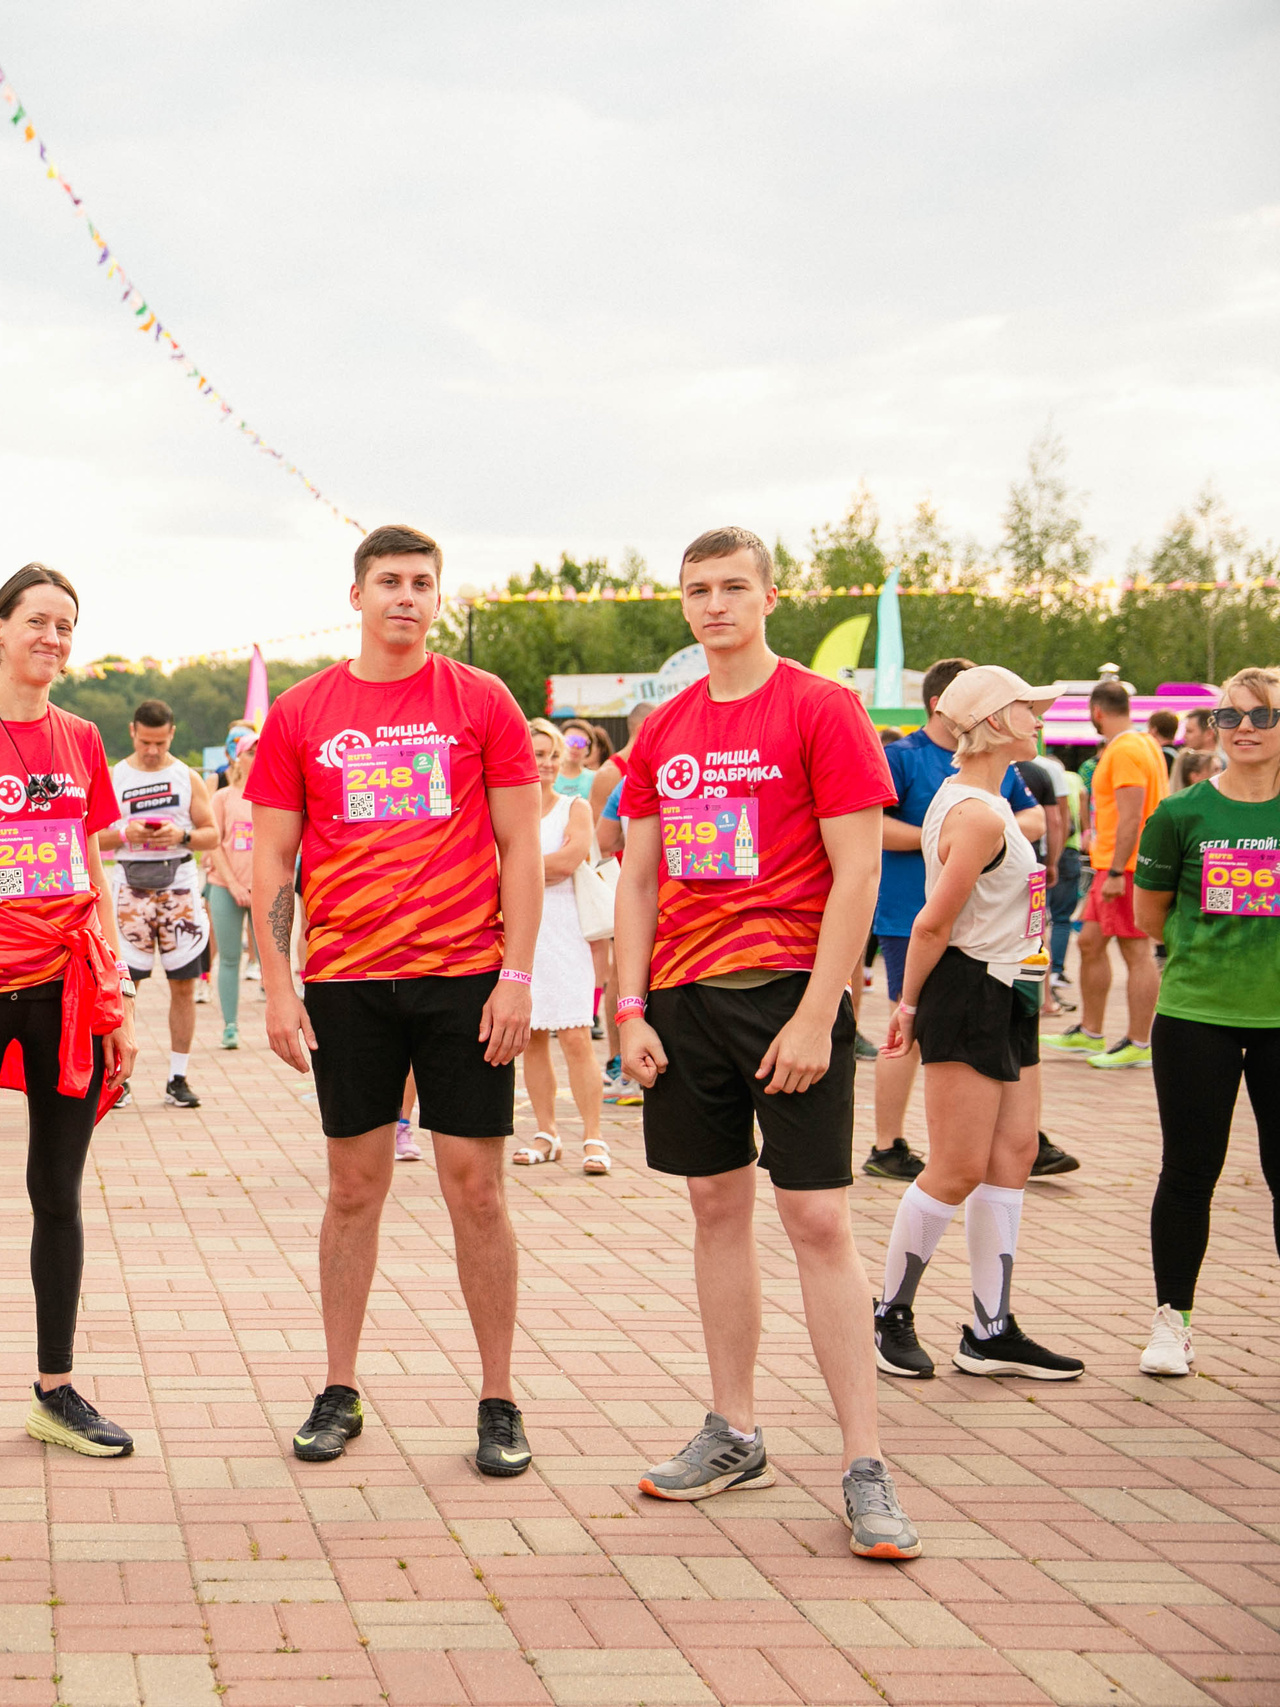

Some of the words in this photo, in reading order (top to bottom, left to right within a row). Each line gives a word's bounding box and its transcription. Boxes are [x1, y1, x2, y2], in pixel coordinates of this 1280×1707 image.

[376, 722, 438, 738] ПИЦЦА
[705, 749, 760, 766] ПИЦЦА
[346, 767, 414, 790] 248
[702, 765, 783, 783] ФАБРИКА
[663, 822, 718, 845] 249
[1207, 867, 1275, 887] 096
